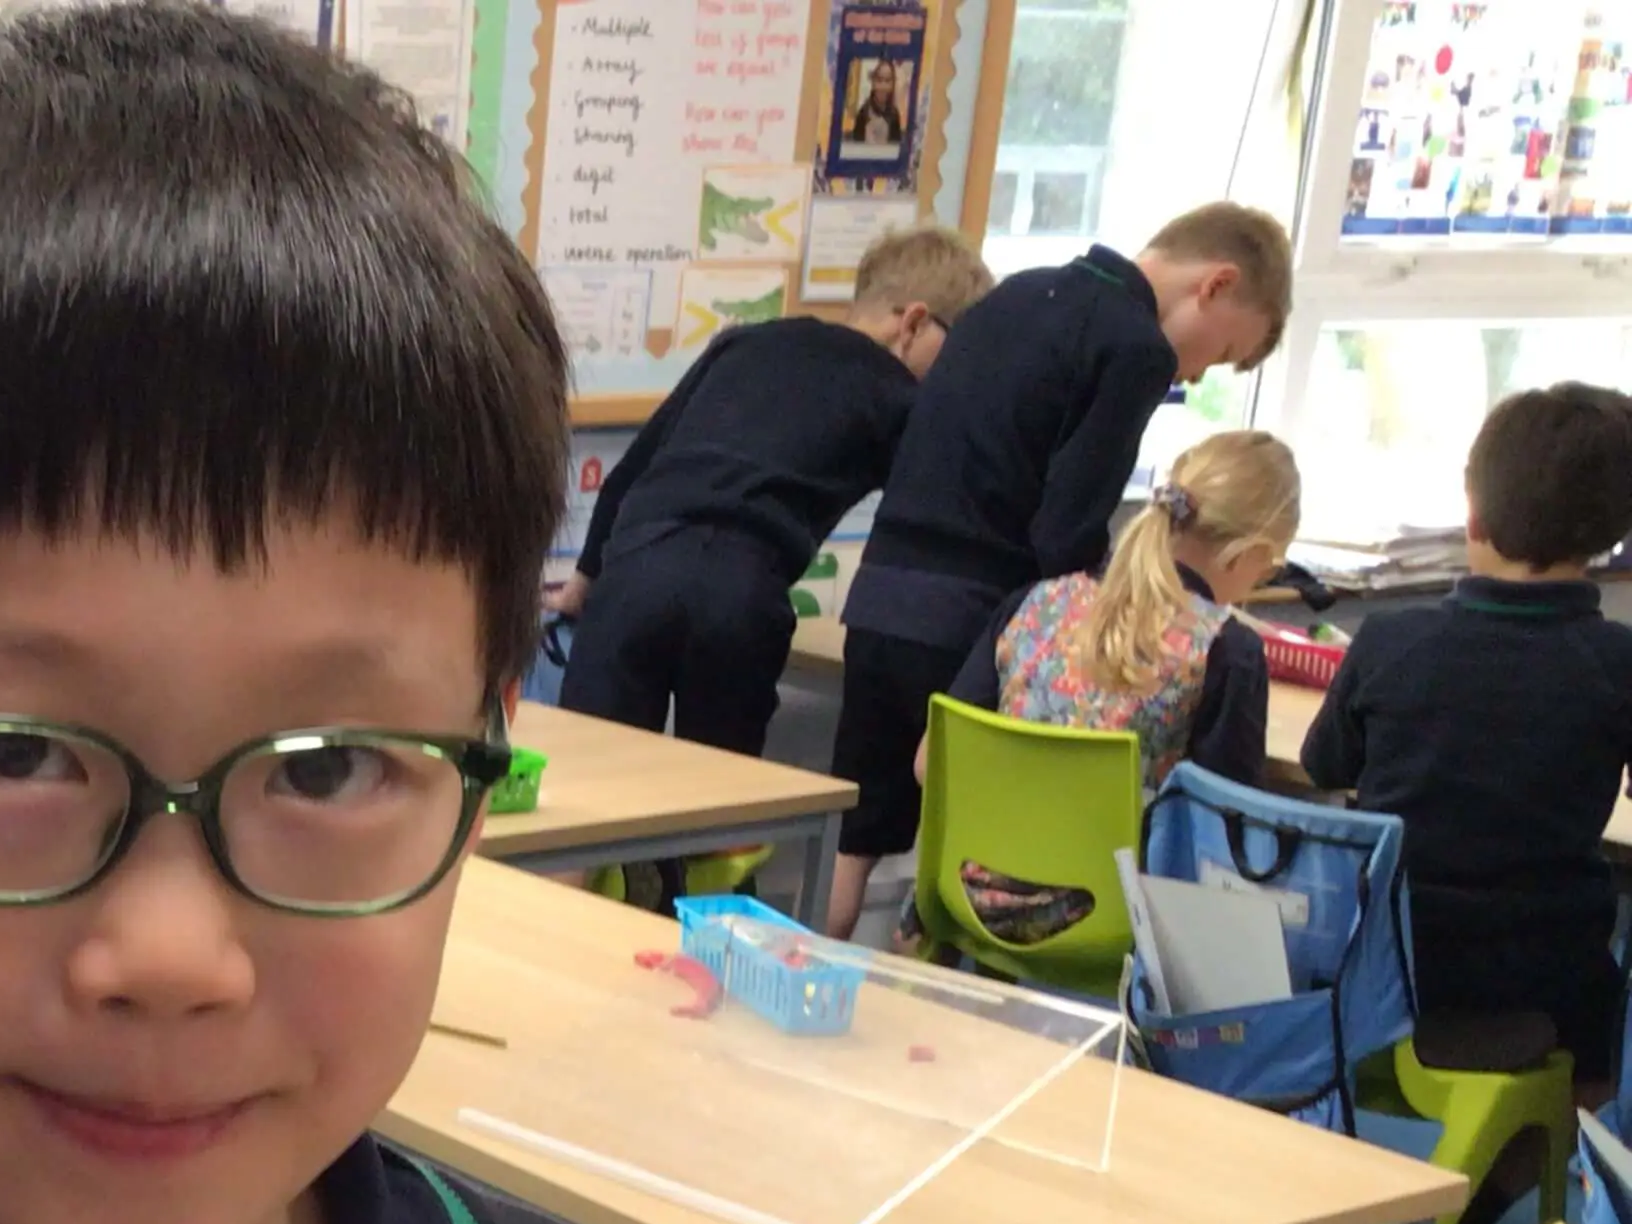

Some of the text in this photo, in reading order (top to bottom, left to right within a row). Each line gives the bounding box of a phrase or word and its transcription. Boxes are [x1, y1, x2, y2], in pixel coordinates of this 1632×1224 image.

[581, 16, 654, 45] Multiple
[568, 205, 608, 225] total
[625, 244, 694, 272] operation
